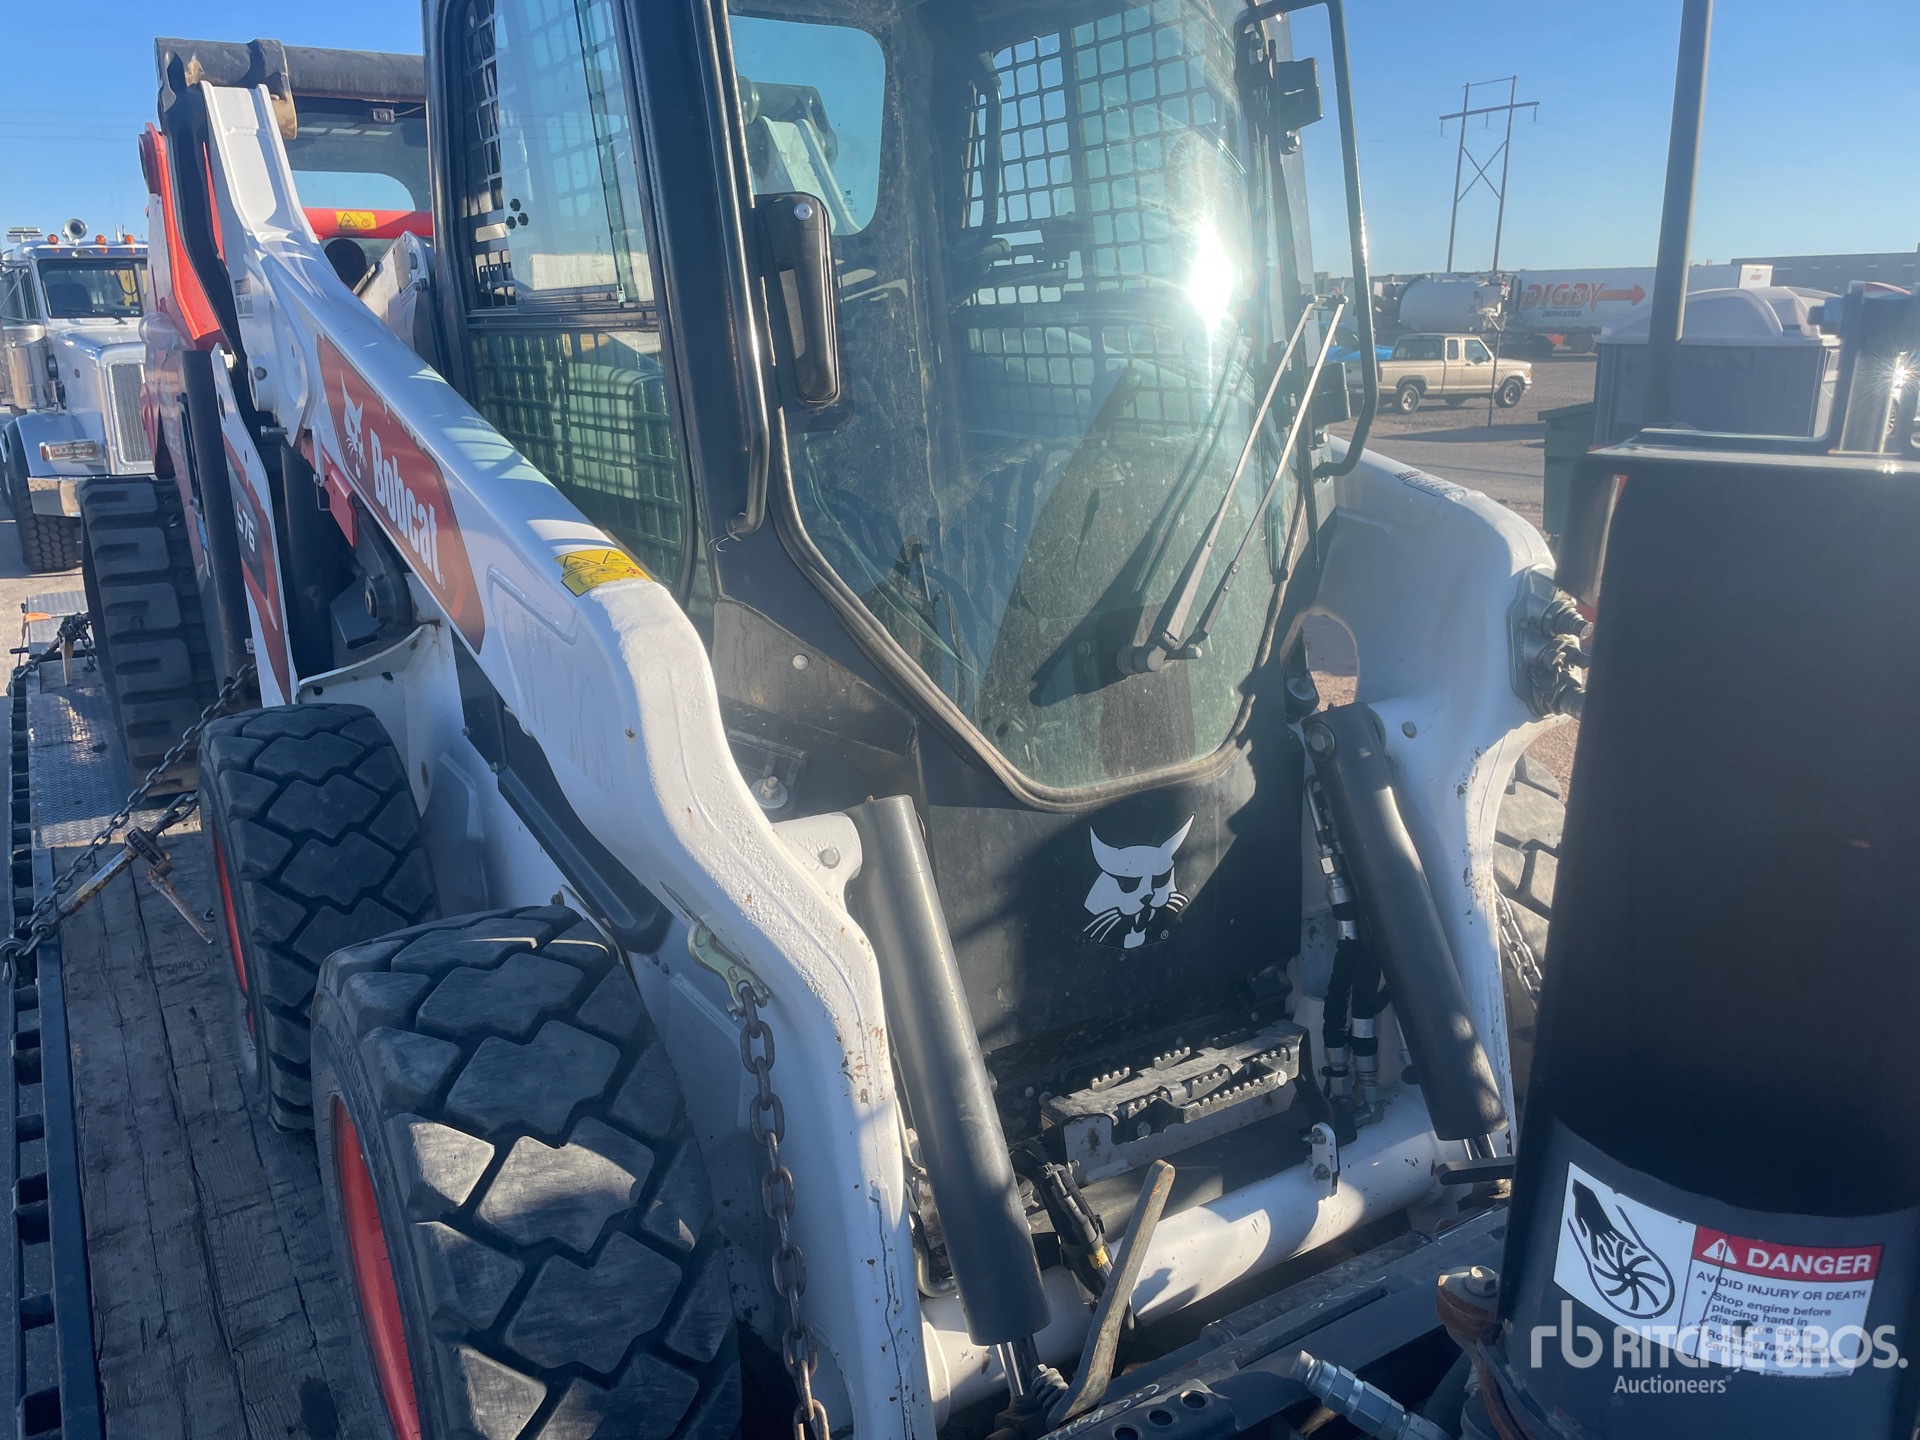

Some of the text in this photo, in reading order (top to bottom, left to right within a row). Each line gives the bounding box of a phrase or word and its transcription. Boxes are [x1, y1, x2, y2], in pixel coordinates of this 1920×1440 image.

[1521, 282, 1607, 311] DIGBY
[370, 428, 441, 584] Bobcat
[1746, 1247, 1872, 1275] DANGER
[1696, 1271, 1866, 1301] AVOID INJURY OR DEATH
[1711, 1303, 1808, 1327] placing hand in
[1712, 1291, 1832, 1317] Stop engine before
[1707, 1329, 1761, 1350] Rotating
[1764, 1342, 1784, 1352] fan
[1776, 1327, 1811, 1337] chute
[1705, 1341, 1728, 1353] can
[1731, 1348, 1767, 1361] crush
